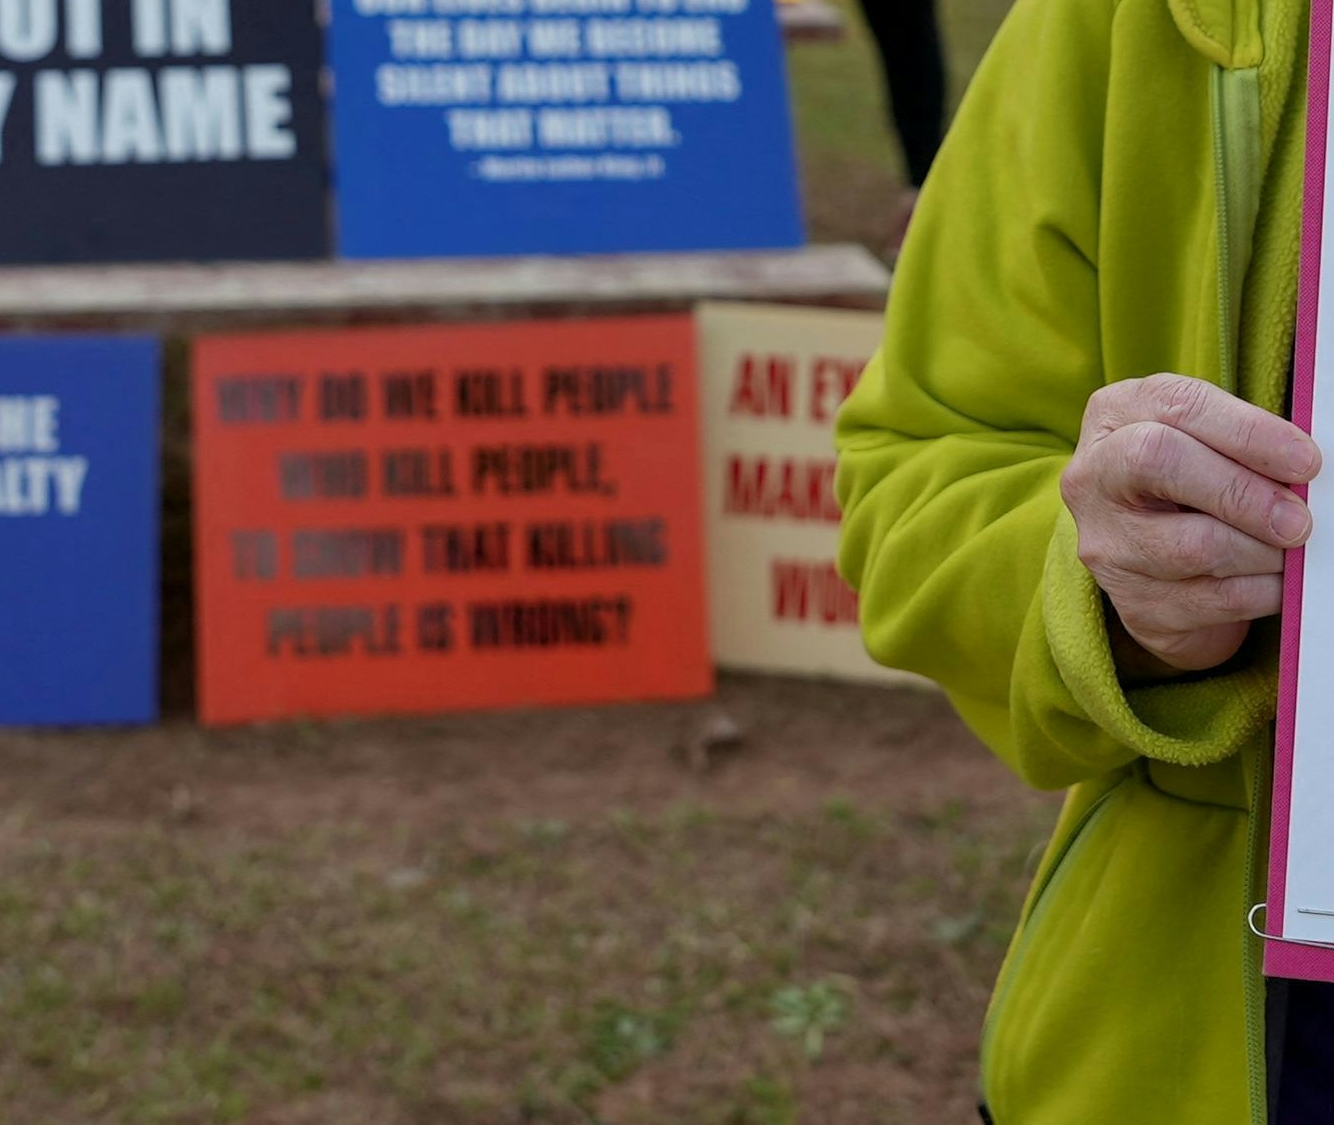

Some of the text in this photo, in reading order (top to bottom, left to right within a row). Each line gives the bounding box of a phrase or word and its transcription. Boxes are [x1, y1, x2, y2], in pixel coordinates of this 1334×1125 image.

[389, 19, 720, 57] THE DAY WE BECOME
[378, 63, 739, 104] SILENT ABOUT THINGS
[36, 64, 296, 164] NAME
[449, 109, 531, 148] THAT
[219, 365, 673, 423] WHY DO WE KILL PEOPLE
[730, 356, 795, 419] AN
[281, 444, 613, 501] WHO KILL PEOPLE,
[231, 520, 665, 580] TO SHOW THAT KILLING
[774, 558, 858, 624] WO
[271, 597, 630, 655] PEOPLE IS WRONG?
